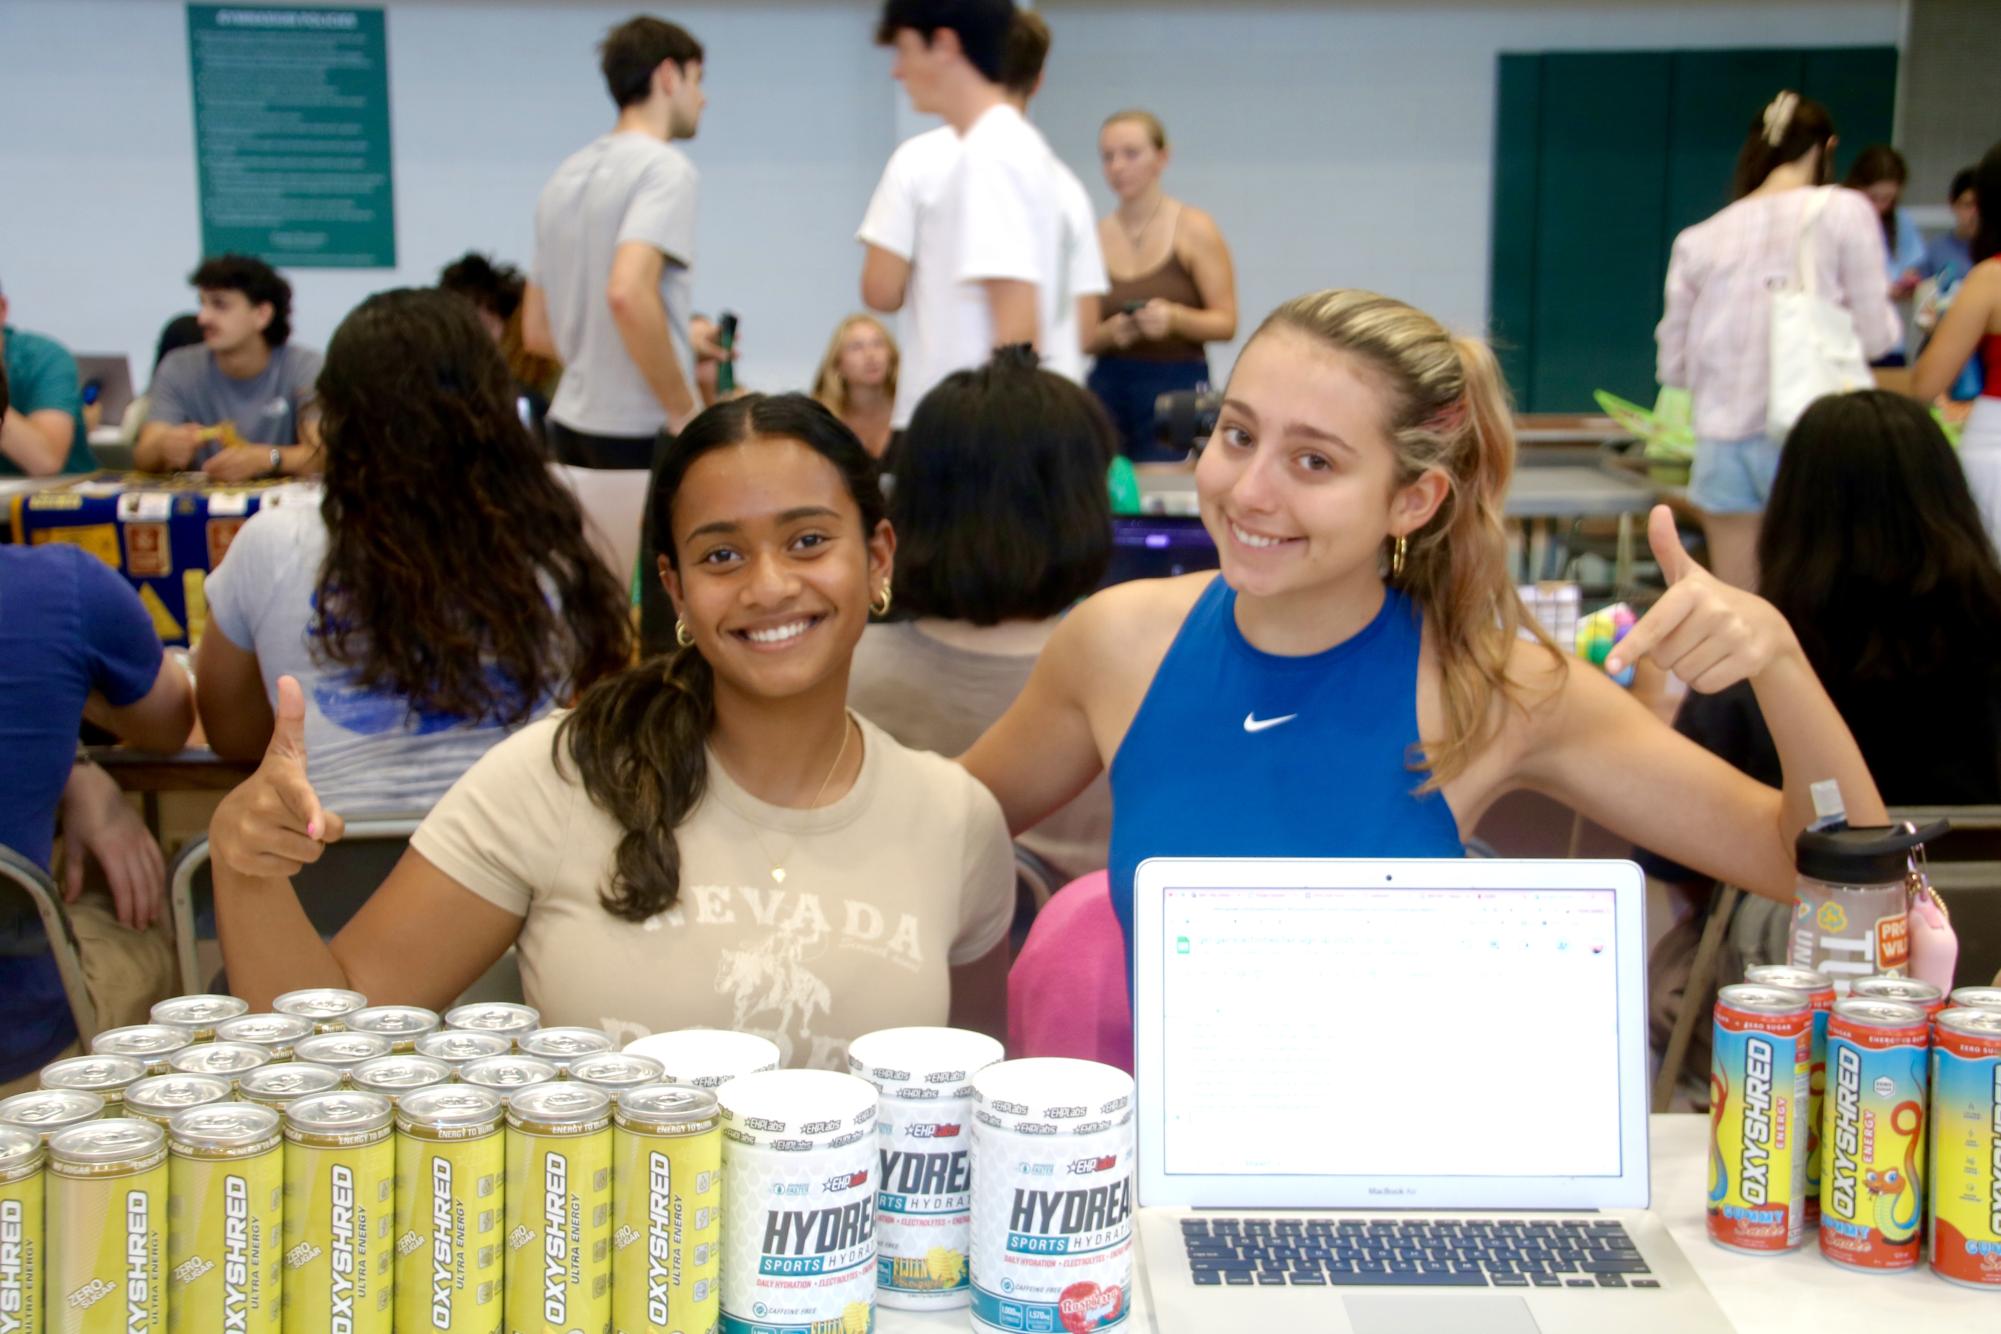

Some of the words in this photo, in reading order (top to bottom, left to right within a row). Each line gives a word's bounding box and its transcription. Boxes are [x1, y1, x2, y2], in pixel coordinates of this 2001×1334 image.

[438, 1126, 466, 1138] ENERGY
[468, 1127, 477, 1137] TO
[552, 1123, 583, 1134] ENERGY
[656, 1123, 686, 1134] ENERGY
[687, 1121, 697, 1132] TO
[1740, 1037, 1773, 1206] OXYSHRED
[1775, 1096, 1787, 1150] ENERGY
[1832, 1045, 1861, 1219] OXYSHRED
[1862, 1108, 1875, 1164] ENERGY
[879, 1148, 970, 1195] YDRE
[456, 1200, 465, 1248] ENERGY
[571, 1194, 580, 1243] ENERGY
[674, 1195, 683, 1245] ENERGY
[879, 1194, 903, 1208] RTS
[910, 1195, 970, 1210] HYDRAT
[1723, 1203, 1784, 1225] GUMMY
[252, 1216, 261, 1266] ENERGY
[286, 1241, 311, 1265] ZERO
[331, 1163, 353, 1334] OXYSHRED
[358, 1205, 367, 1255] ENERGY
[432, 1156, 452, 1330] OXYSHRED
[544, 1151, 567, 1326] OXYSHRED
[648, 1151, 670, 1327] OXYSHRED
[1011, 1236, 1066, 1251] SPORTS
[25, 1239, 33, 1290] ENERGY
[151, 1230, 159, 1281] ENERGY
[173, 1255, 202, 1280] ZERO
[184, 1259, 215, 1285] SUGAR
[225, 1175, 247, 1334] XYSHRED
[456, 1252, 465, 1290] ULTRA
[570, 1246, 579, 1284] ULTRA
[673, 1247, 681, 1286] ULTRA
[764, 1258, 820, 1273] SPORTS
[251, 1271, 260, 1309] ULTRA
[357, 1260, 366, 1298] ULTRA
[151, 1286, 159, 1325] ULTRA
